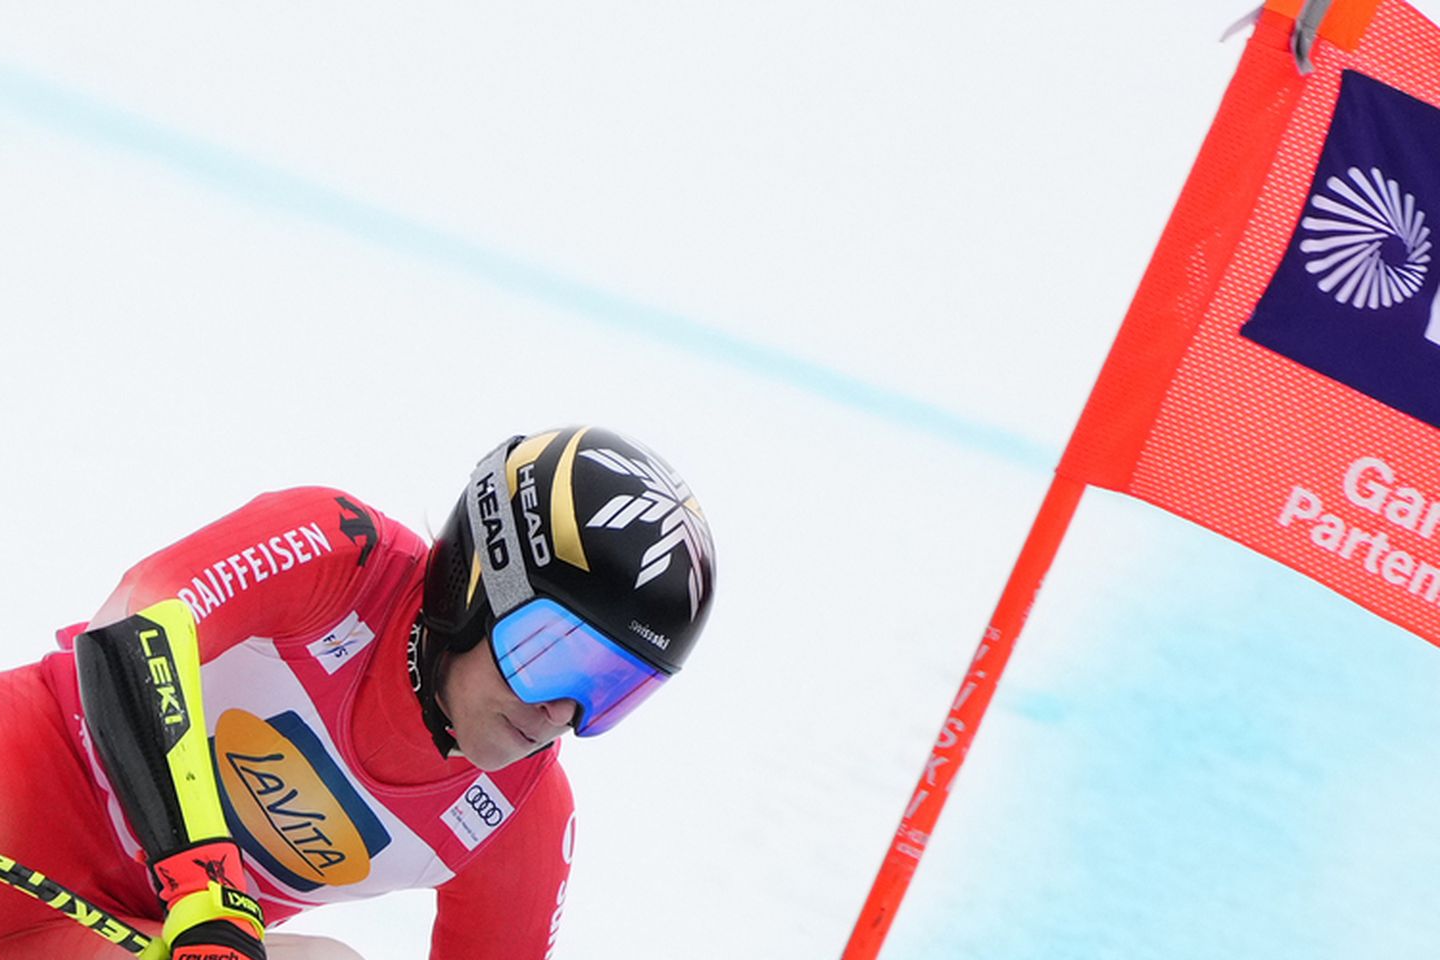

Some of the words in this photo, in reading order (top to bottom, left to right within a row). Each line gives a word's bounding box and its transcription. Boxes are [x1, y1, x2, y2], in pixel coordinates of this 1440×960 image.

[475, 472, 510, 572] HEAD
[518, 463, 551, 568] HEAD
[178, 522, 333, 625] RAIFFEISEN
[138, 628, 183, 726] LEKI
